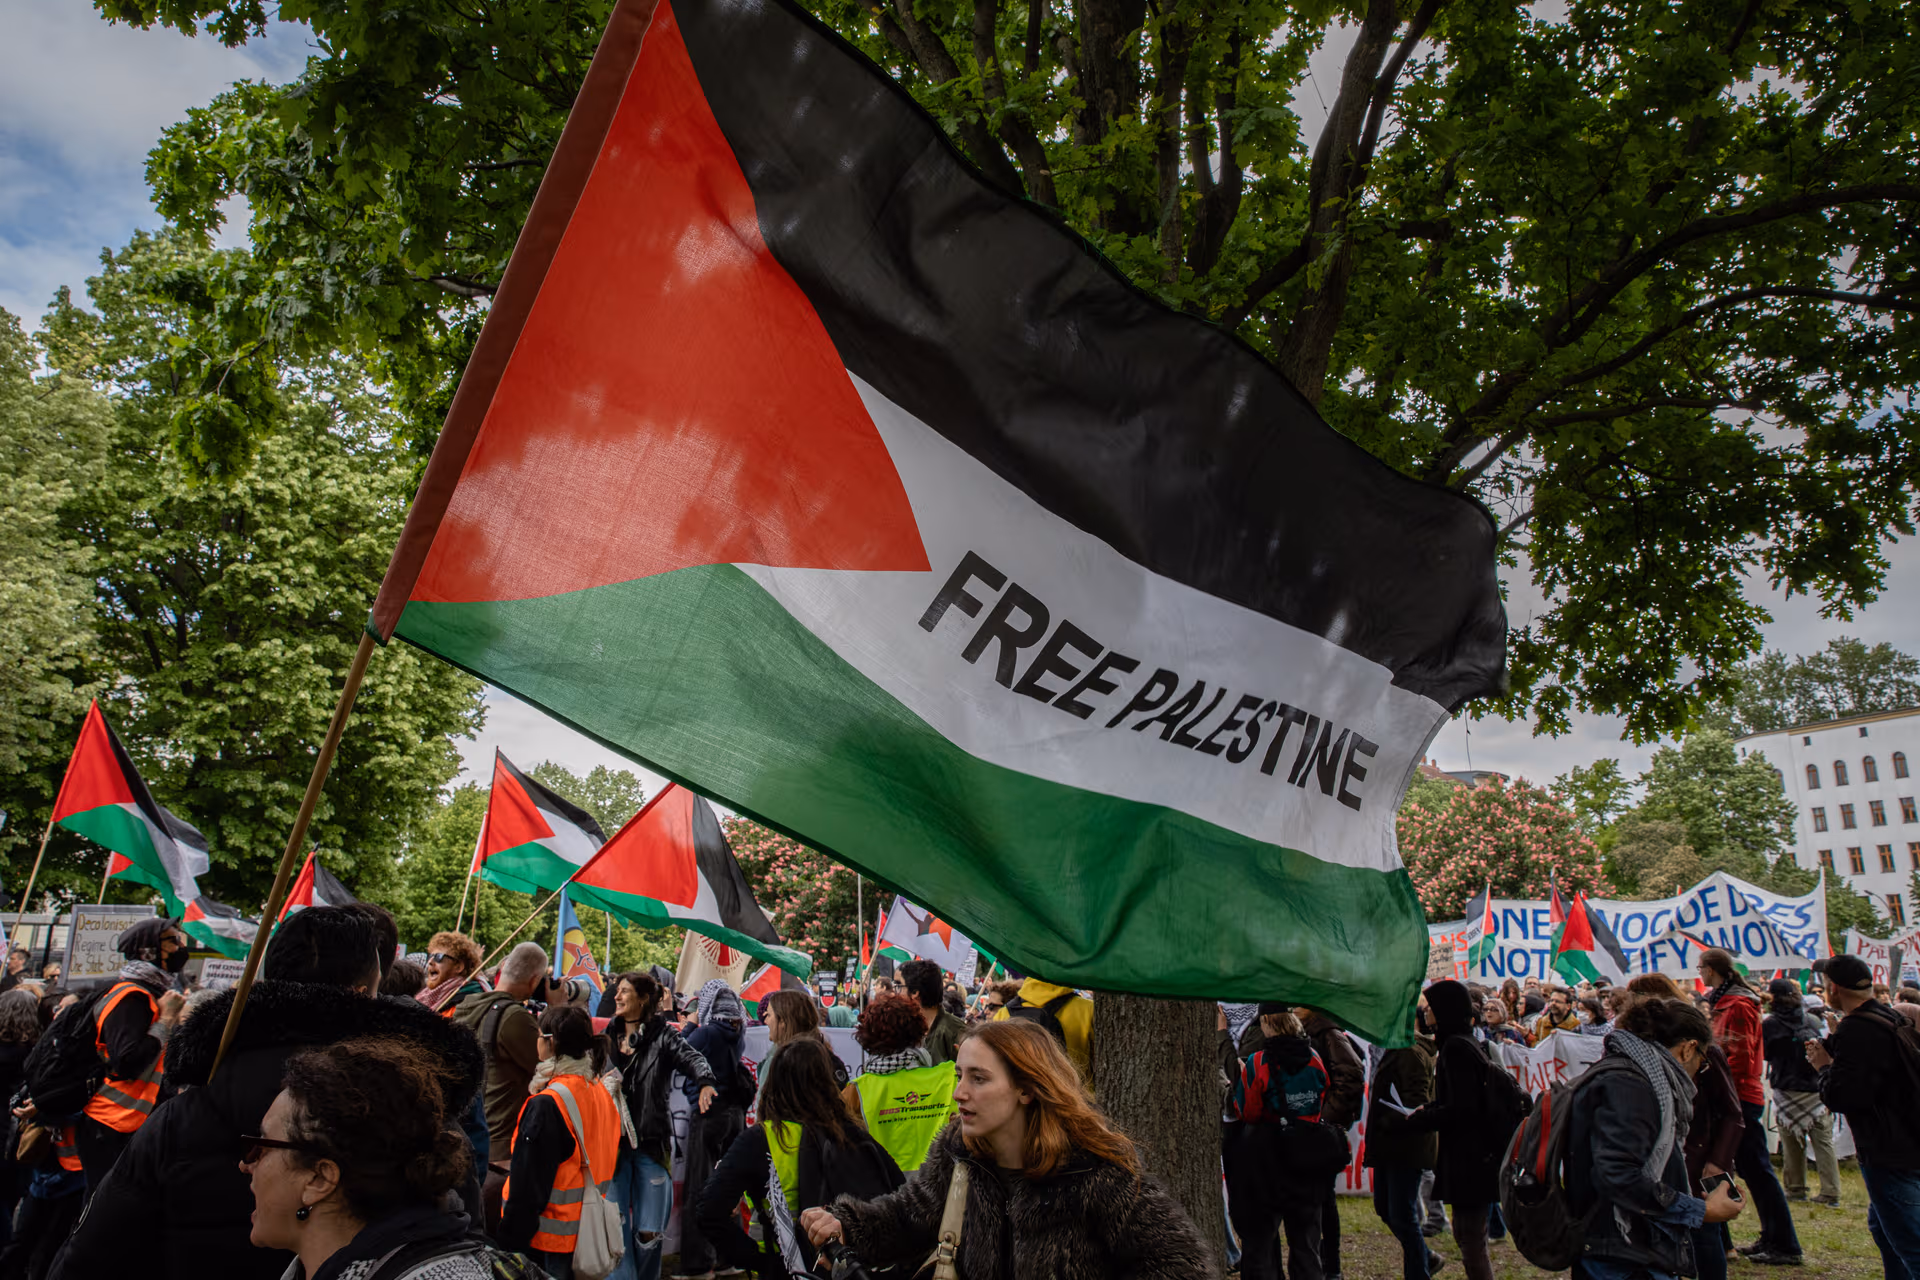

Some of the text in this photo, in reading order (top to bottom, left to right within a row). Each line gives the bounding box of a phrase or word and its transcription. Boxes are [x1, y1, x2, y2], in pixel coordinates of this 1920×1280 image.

[918, 550, 1379, 811] FREE PALESTINE
[74, 934, 106, 956] Regime
[1480, 946, 1551, 981] NOT
[1621, 936, 1690, 974] TIFY
[1453, 960, 1469, 980] IT
